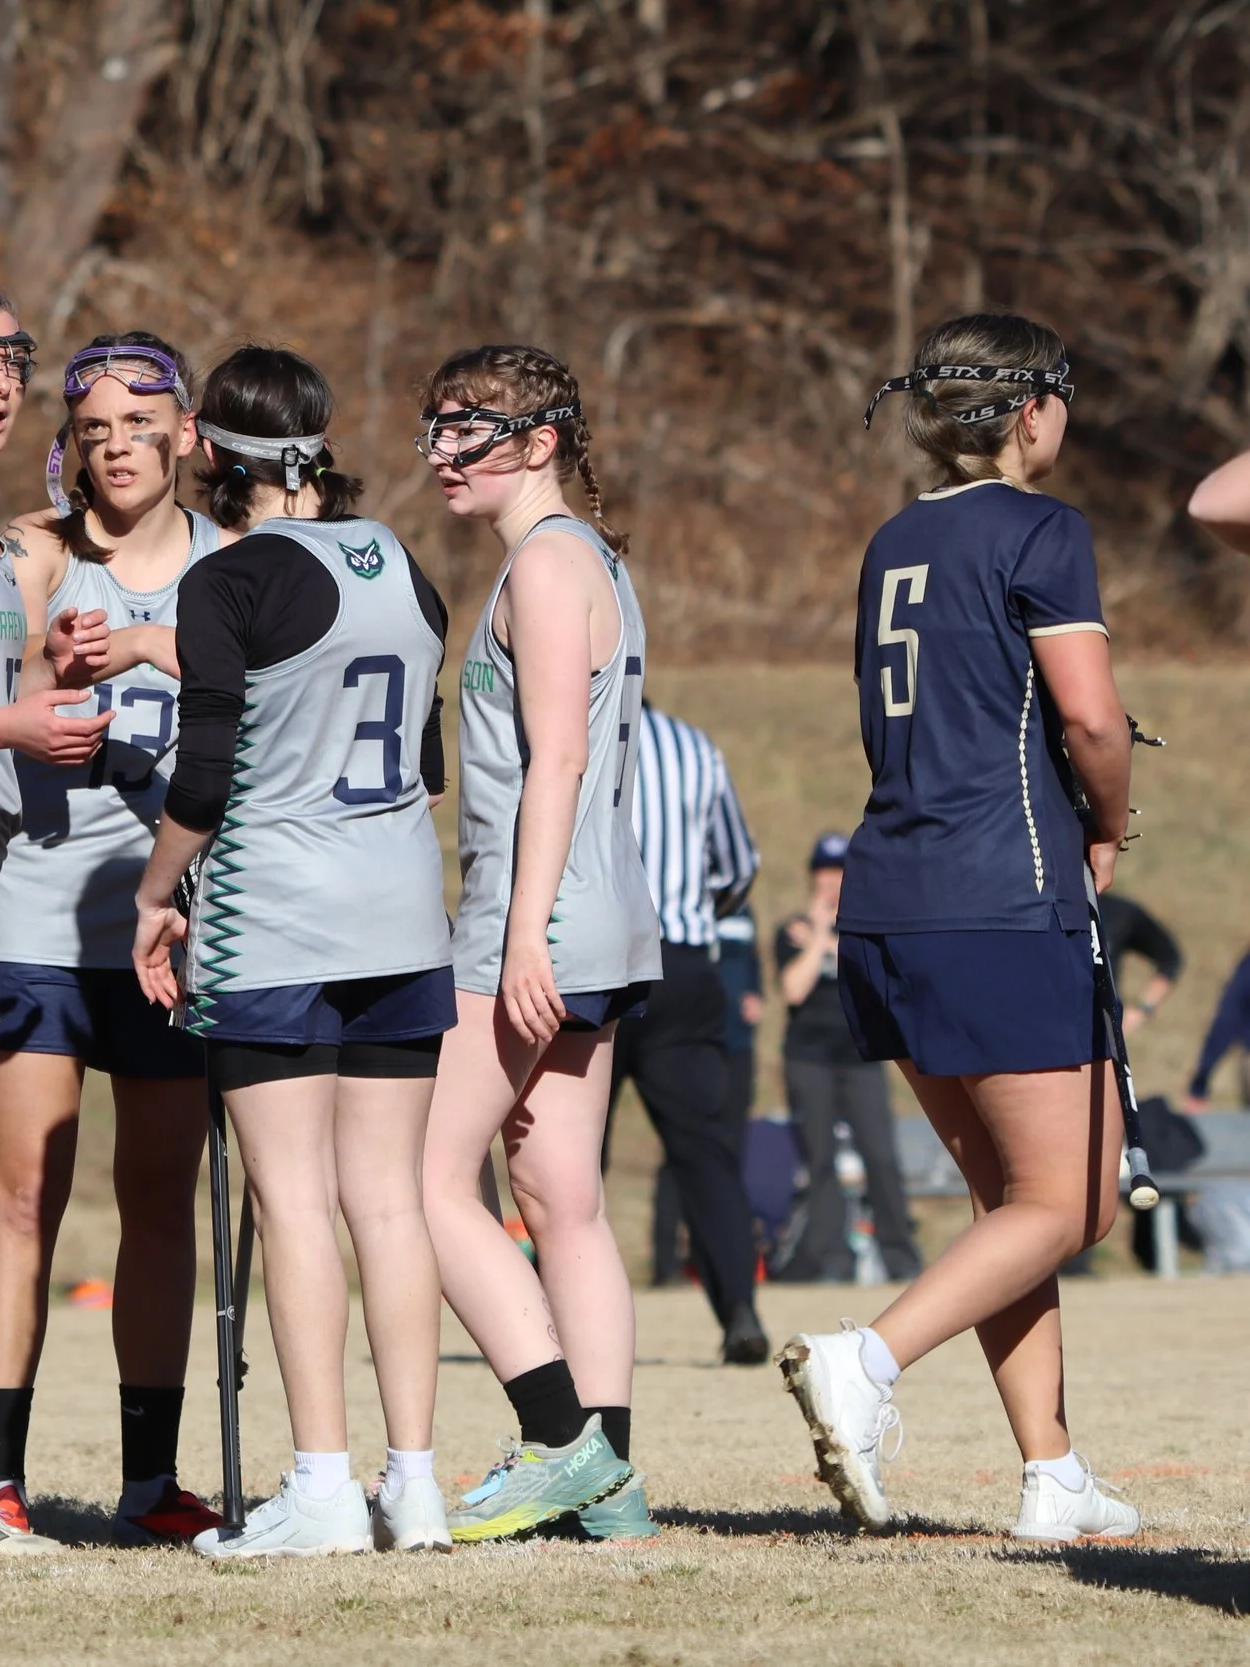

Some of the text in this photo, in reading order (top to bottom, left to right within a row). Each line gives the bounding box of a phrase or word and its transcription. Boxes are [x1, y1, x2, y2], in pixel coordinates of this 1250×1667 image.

[914, 367, 928, 380] TX
[938, 366, 981, 378] STX
[545, 406, 574, 422] STX
[232, 442, 282, 458] casca
[878, 563, 930, 717] 5
[463, 660, 495, 692] SON
[89, 683, 176, 792] 13
[333, 654, 406, 805] 3
[563, 1437, 603, 1478] HOKA
